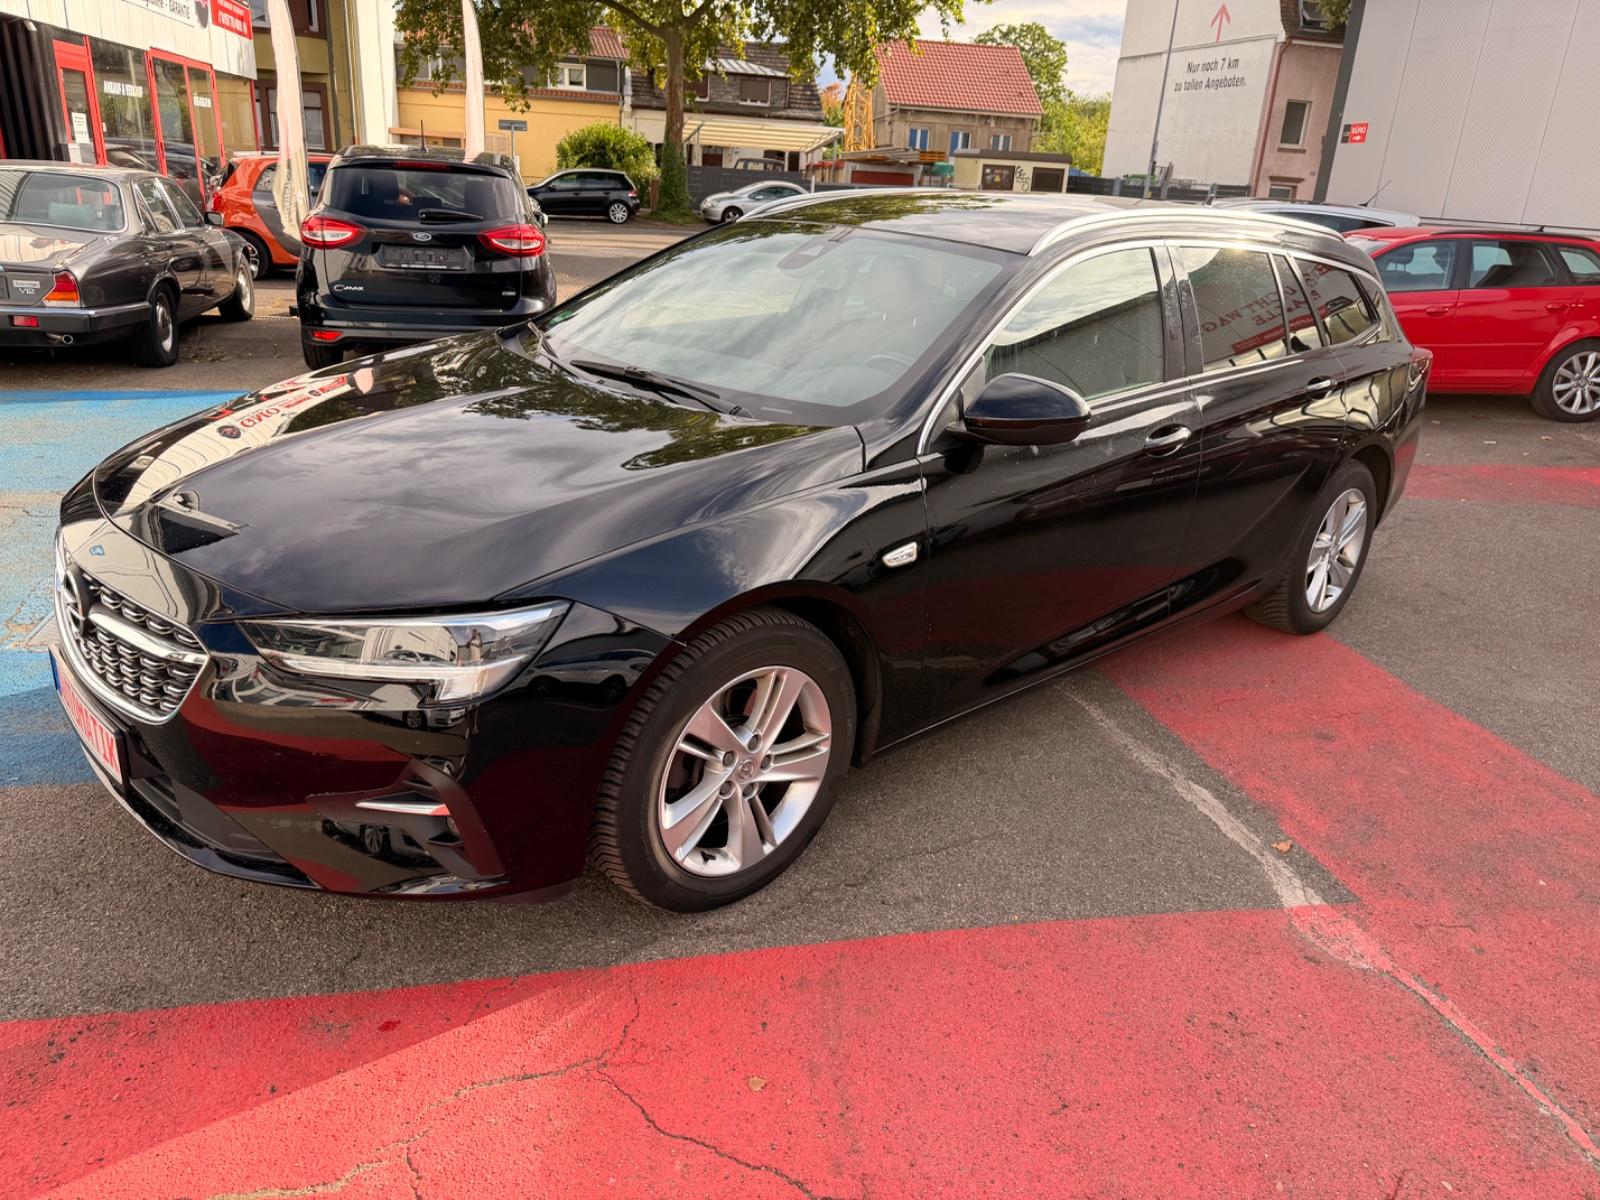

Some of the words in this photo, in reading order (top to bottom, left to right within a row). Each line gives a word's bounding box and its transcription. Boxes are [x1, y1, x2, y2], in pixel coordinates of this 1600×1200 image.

[1186, 61, 1200, 74] Nur
[1201, 58, 1219, 72] noch
[1220, 57, 1227, 71] 7
[1227, 57, 1240, 69] km
[1174, 82, 1182, 92] zu
[1184, 78, 1203, 91] tollen
[1205, 75, 1247, 91] Angeboten.
